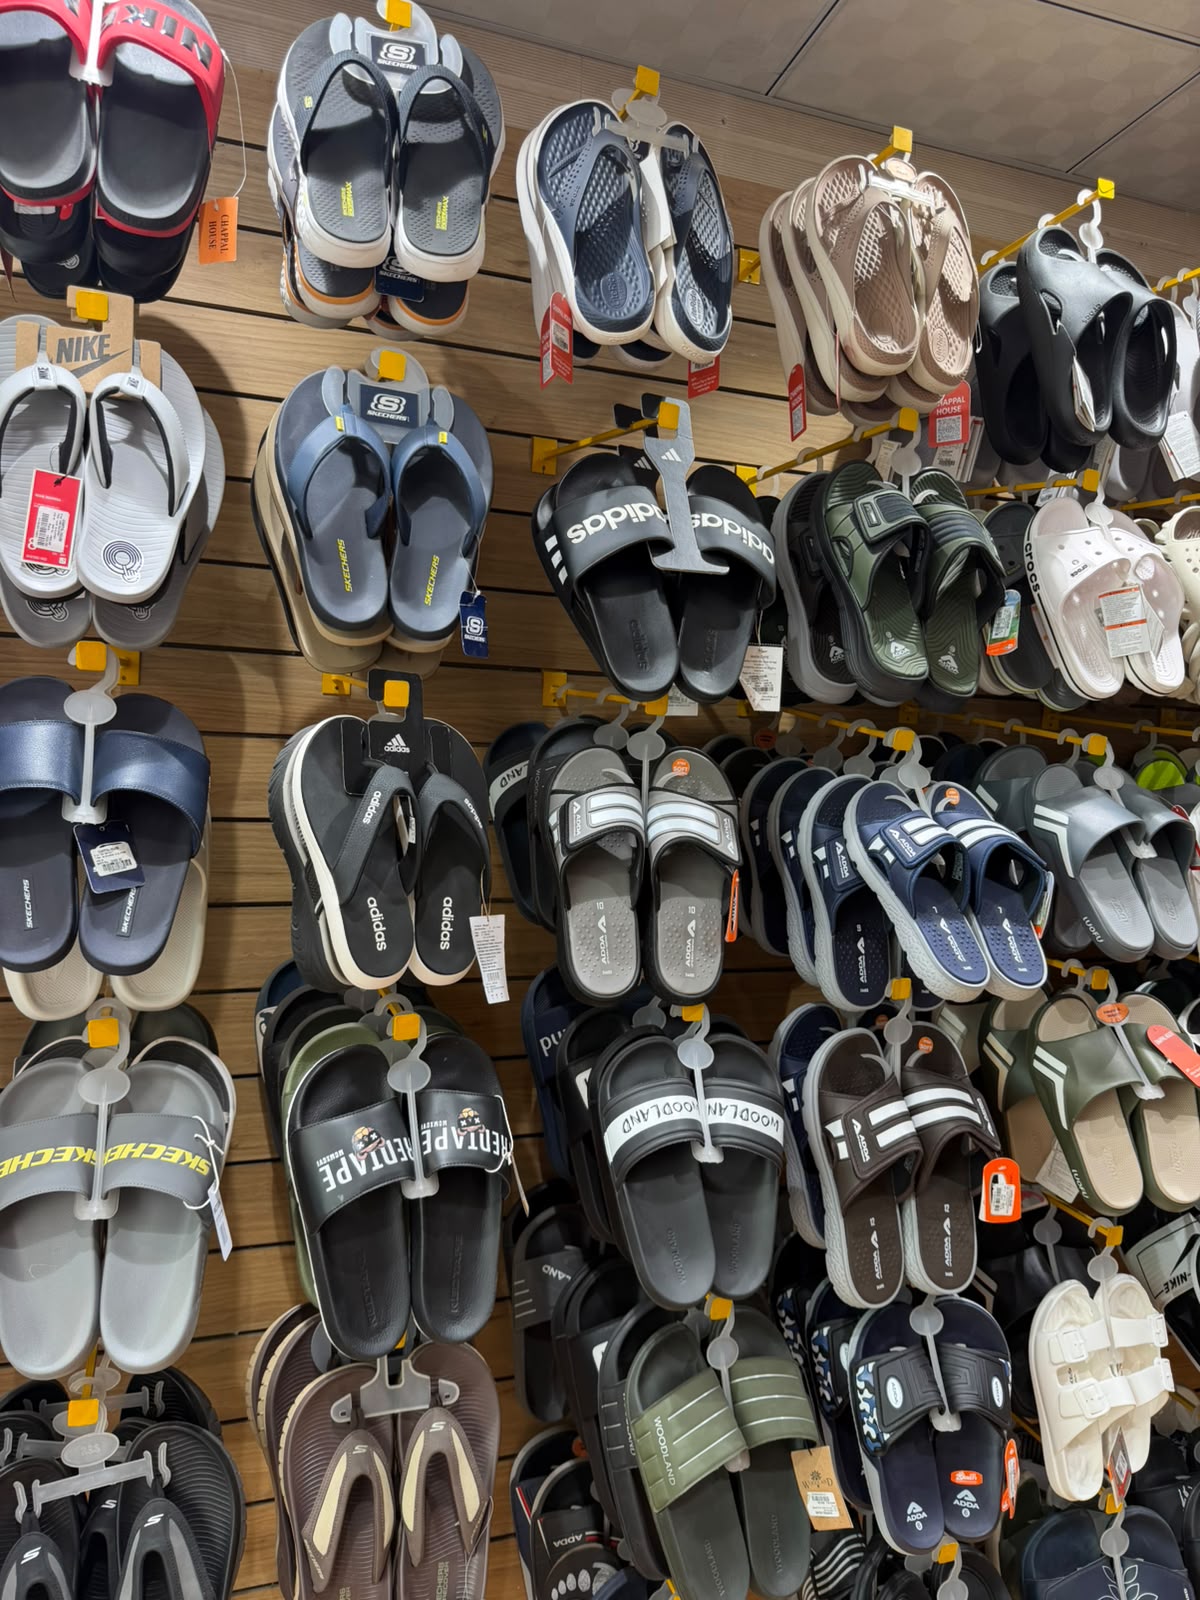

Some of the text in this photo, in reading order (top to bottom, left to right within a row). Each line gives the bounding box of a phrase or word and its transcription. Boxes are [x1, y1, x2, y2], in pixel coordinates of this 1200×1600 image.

[377, 58, 418, 70] SKECHERS
[208, 220, 217, 251] HOUSE
[220, 213, 229, 255] CHAPPAL
[56, 333, 112, 365] NIKE
[366, 410, 408, 422] SKECHERS
[936, 406, 962, 416] HOUSE
[938, 396, 966, 407] HAPPAL
[336, 538, 354, 593] SKECHERS
[424, 554, 440, 606] SKECHERS
[1024, 542, 1041, 592] crocs
[384, 744, 410, 754] adidas
[362, 790, 382, 826] adidas
[463, 797, 484, 830] adidas
[723, 818, 732, 840] ADDA
[900, 838, 916, 857] ADDA
[840, 854, 850, 878] ADDA
[22, 878, 34, 930] SKECHERS
[366, 896, 387, 952] adidas
[439, 896, 453, 951] adidas
[1082, 916, 1104, 944] LUOFU
[599, 934, 607, 965] ADDA
[684, 938, 692, 968] ADDA
[948, 935, 965, 962] ADDA
[1007, 936, 1021, 963] ADDA
[858, 955, 866, 984] ADDA
[539, 1027, 568, 1057] pu
[707, 1102, 779, 1133] WOODLAN
[859, 1134, 871, 1162] ADDA
[872, 1252, 882, 1280] ADDA
[944, 1237, 952, 1267] ADDA
[1163, 1272, 1188, 1294] NIKE
[653, 1416, 676, 1486] WOODLAND
[906, 1511, 928, 1523] ADDA
[953, 1498, 980, 1510] ADDA
[552, 1532, 583, 1548] ADDA
[436, 1562, 445, 1600] ECHERS
